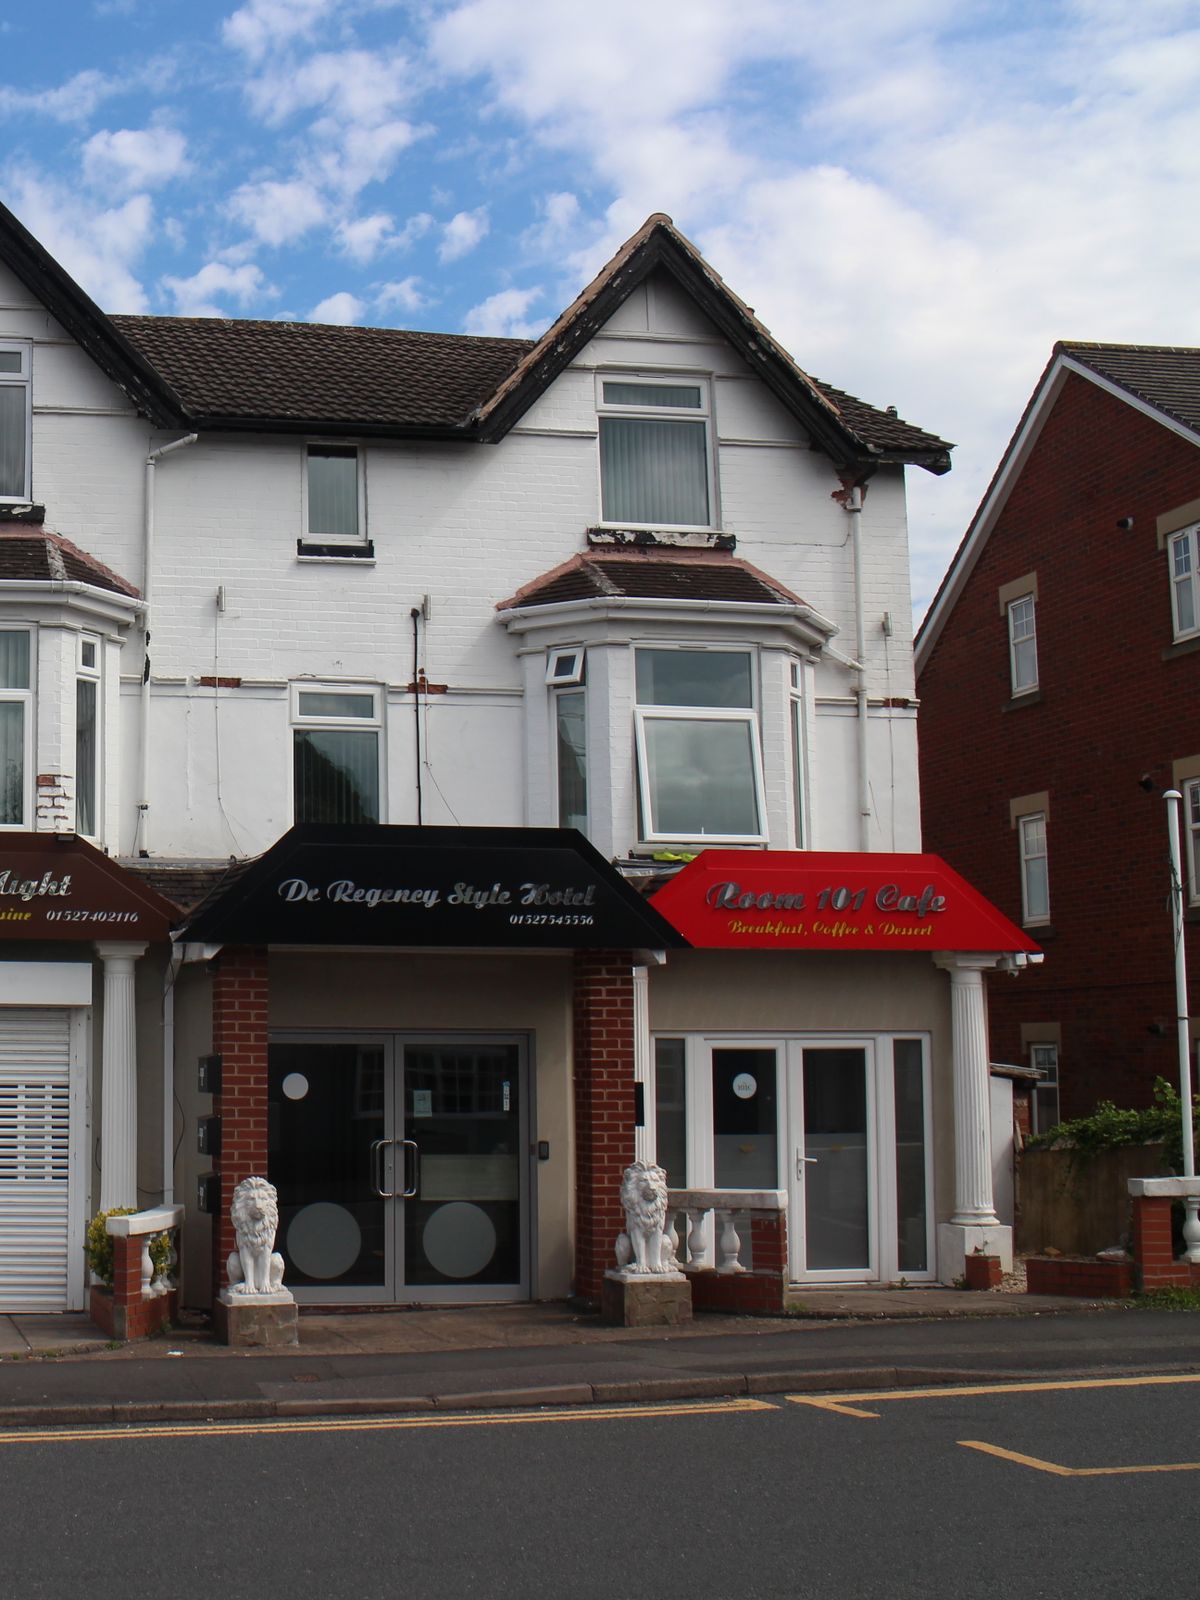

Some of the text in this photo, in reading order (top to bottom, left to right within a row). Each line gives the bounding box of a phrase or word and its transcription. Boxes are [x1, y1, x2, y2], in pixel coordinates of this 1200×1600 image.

[278, 878, 597, 909] De Regency Style Hotel
[706, 881, 947, 918] Room 101 Cafe
[45, 909, 140, 924] 01527402116
[509, 914, 595, 926] 01527545556
[728, 920, 934, 938] Breakfast, Coffee & Dessert
